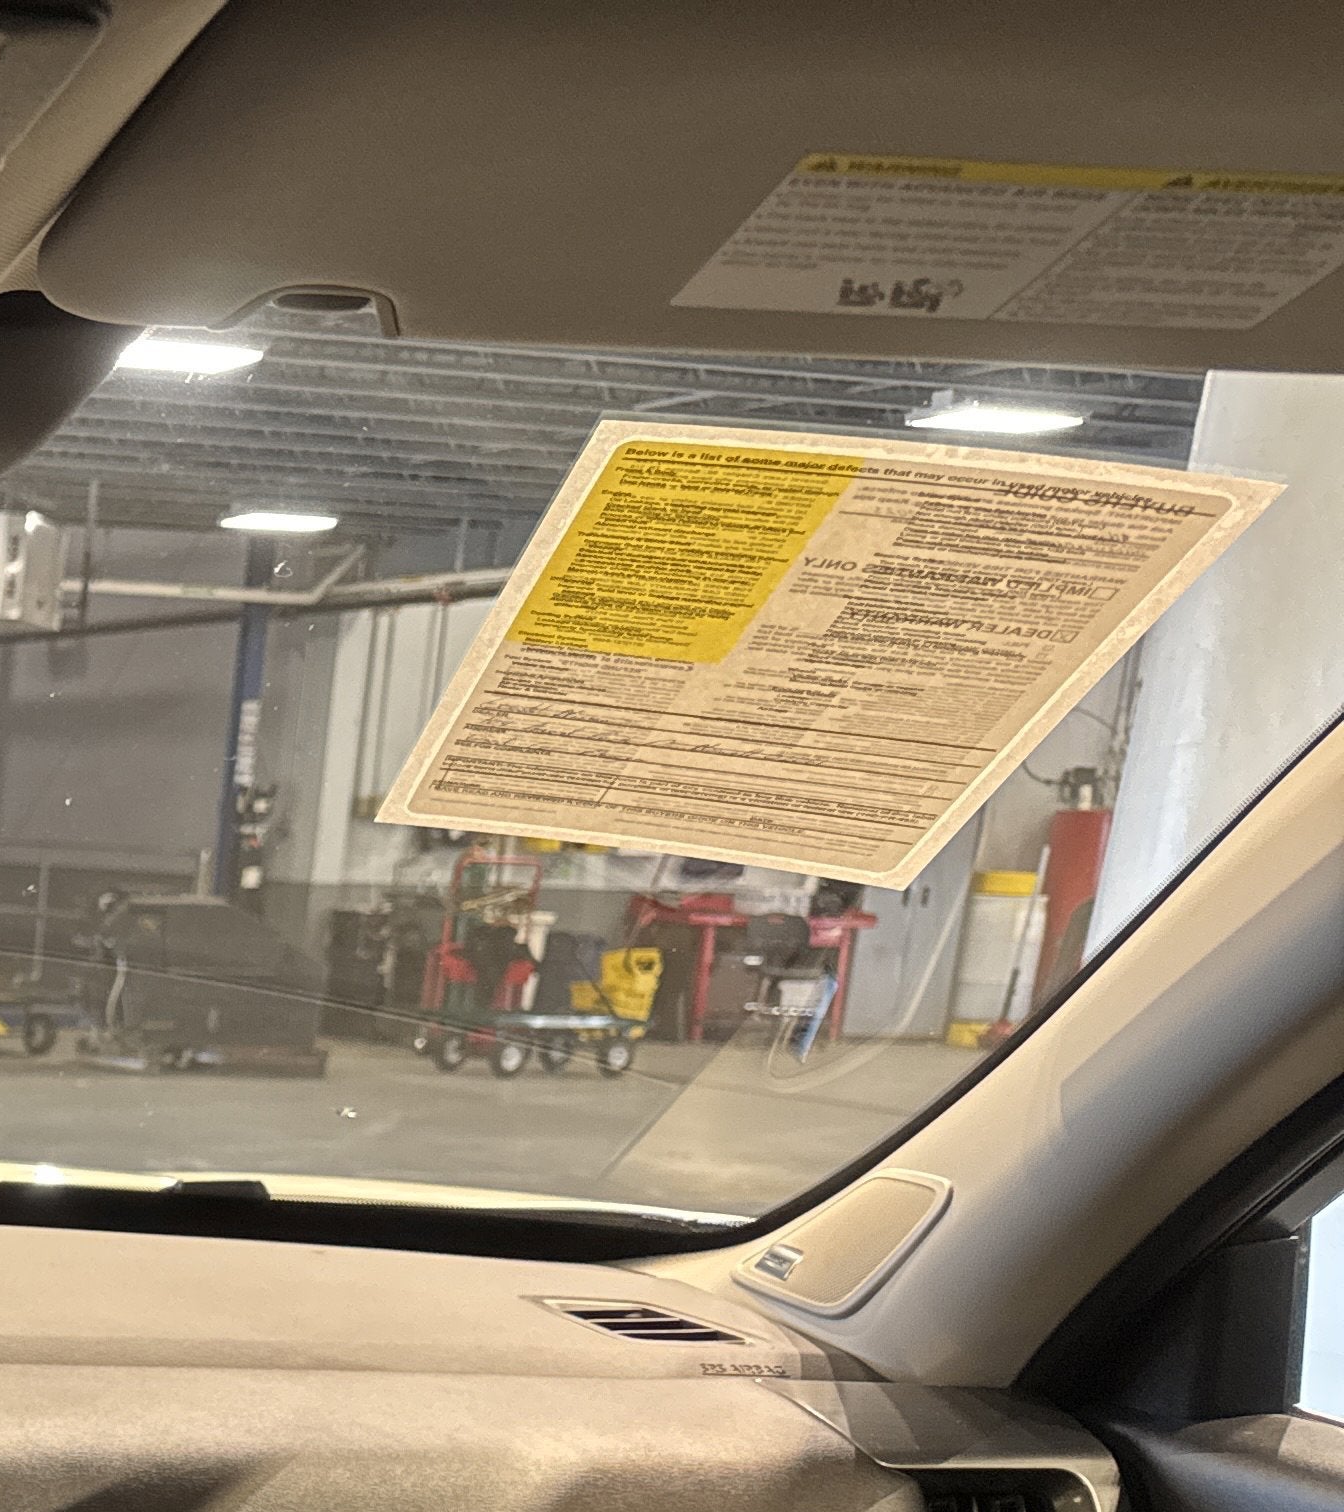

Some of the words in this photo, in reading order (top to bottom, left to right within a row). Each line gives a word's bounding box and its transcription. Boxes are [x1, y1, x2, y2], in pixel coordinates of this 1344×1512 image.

[625, 447, 668, 458] Below
[672, 450, 684, 459] is
[700, 452, 722, 462] list
[827, 463, 879, 475] defects
[883, 468, 912, 478] that
[914, 471, 945, 483] may
[948, 475, 989, 486] occur
